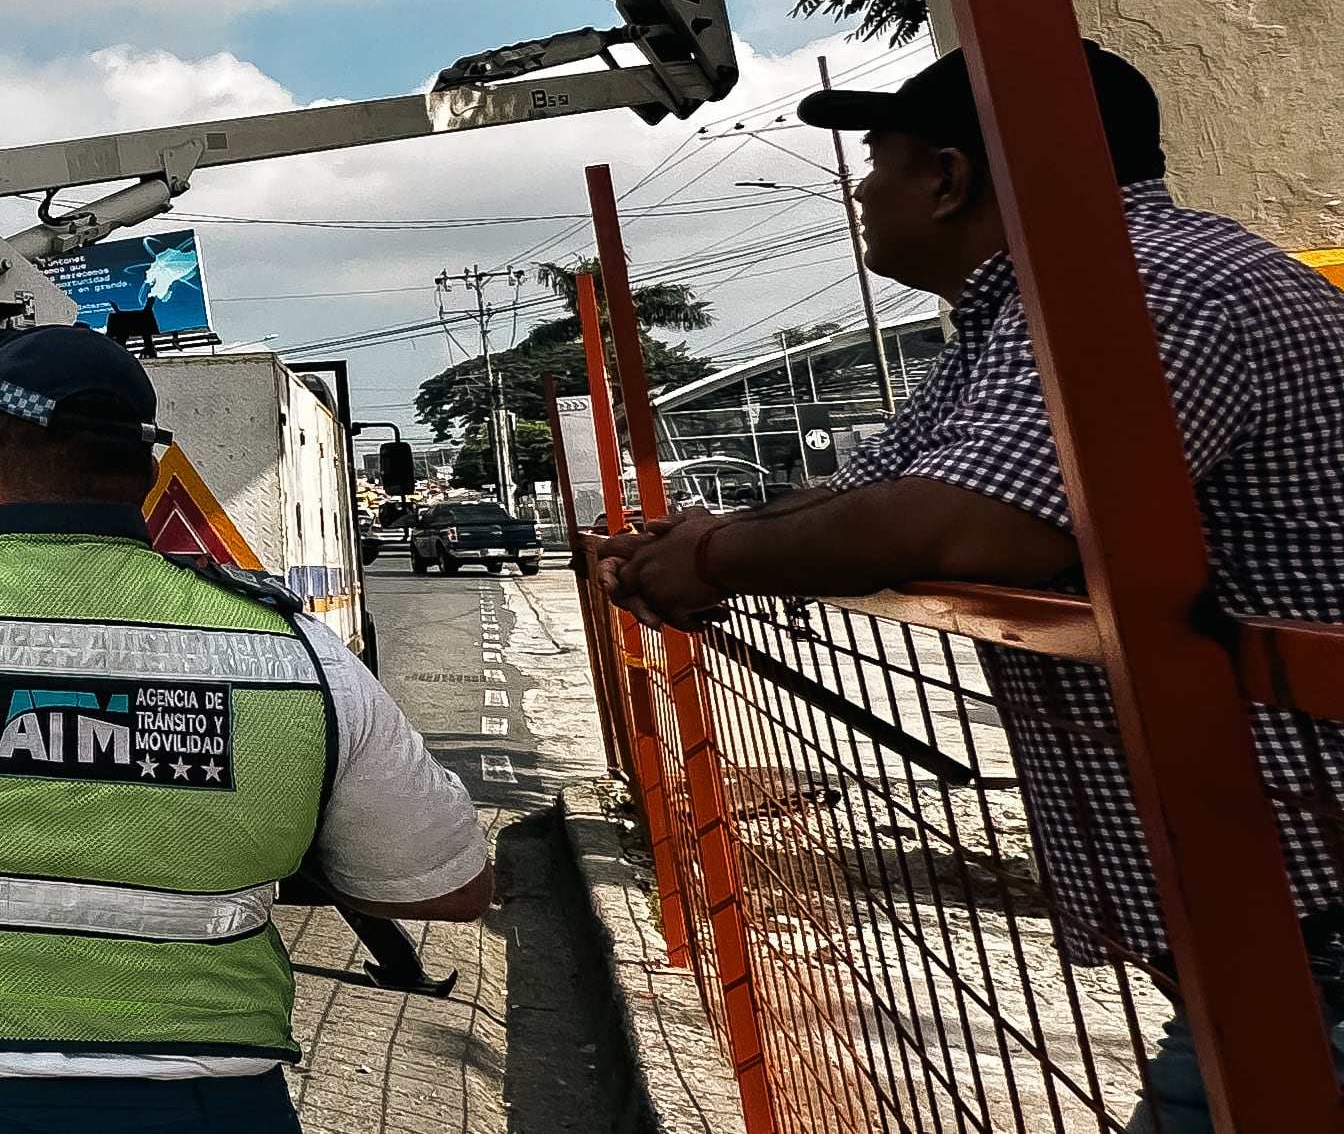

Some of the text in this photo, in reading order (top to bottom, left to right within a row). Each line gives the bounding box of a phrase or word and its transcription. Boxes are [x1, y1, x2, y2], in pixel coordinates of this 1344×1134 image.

[135, 687, 224, 710] AGENCIA DE
[135, 707, 224, 734] TRÁNSITO Y
[135, 731, 224, 755] MOVILIDAD
